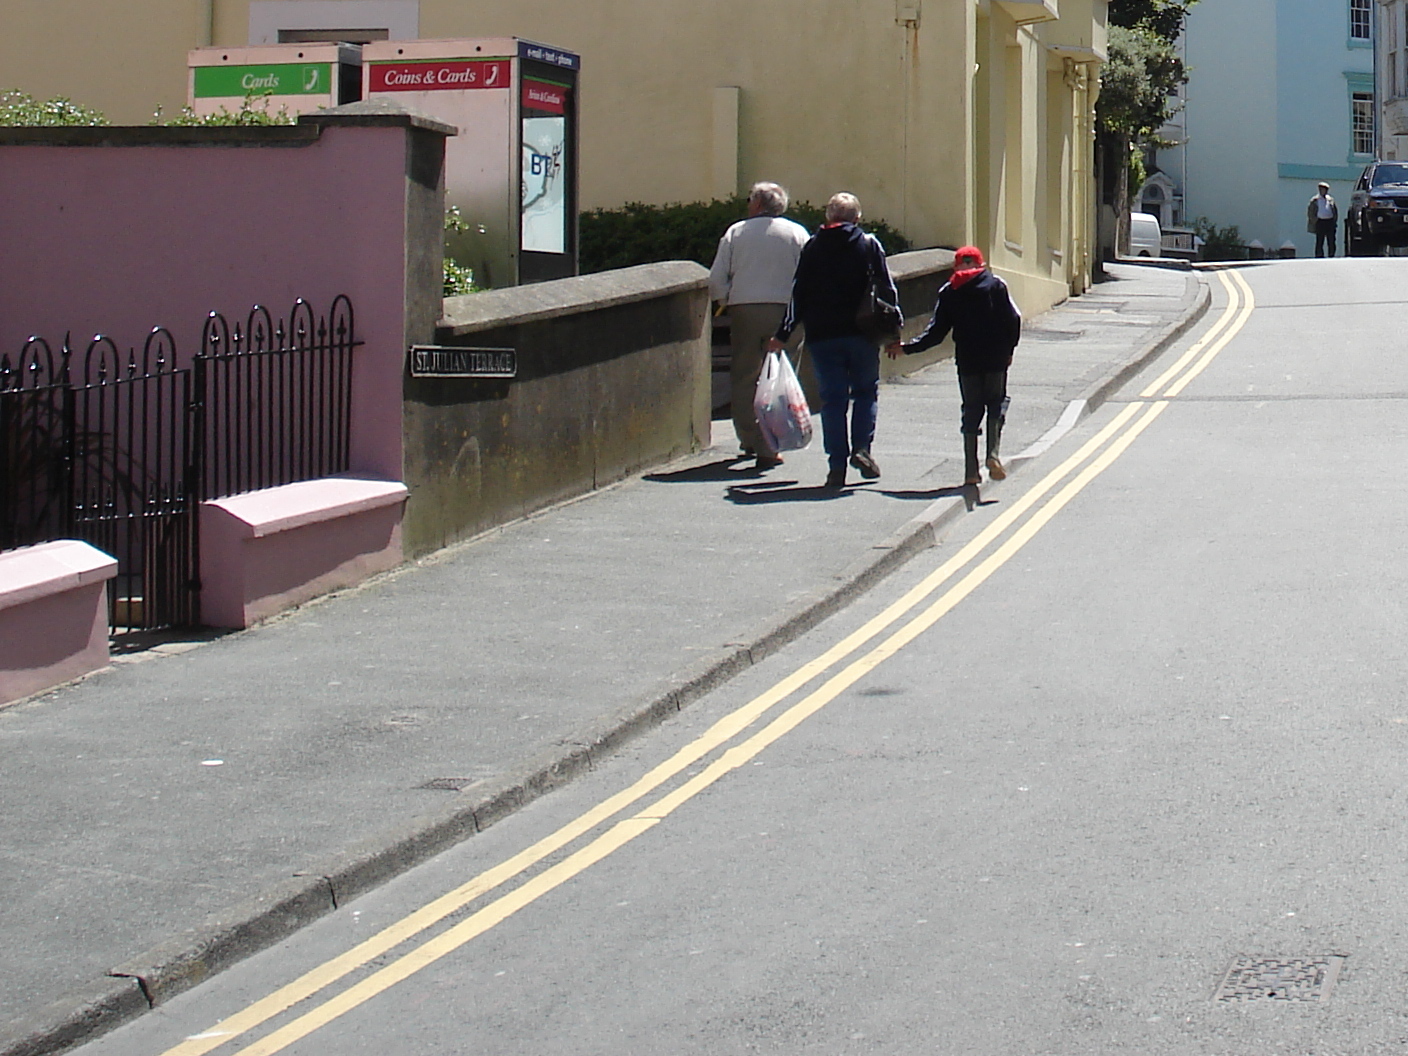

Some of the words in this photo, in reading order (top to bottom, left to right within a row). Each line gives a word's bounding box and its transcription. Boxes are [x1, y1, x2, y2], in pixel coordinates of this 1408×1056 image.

[242, 73, 280, 89] Cards
[384, 69, 422, 85] Coins
[423, 70, 435, 84] &
[437, 68, 477, 84] Cards
[531, 154, 550, 176] BT
[417, 351, 429, 371] ST.
[431, 352, 468, 372] JULIAN
[469, 353, 512, 372] TERRACE
